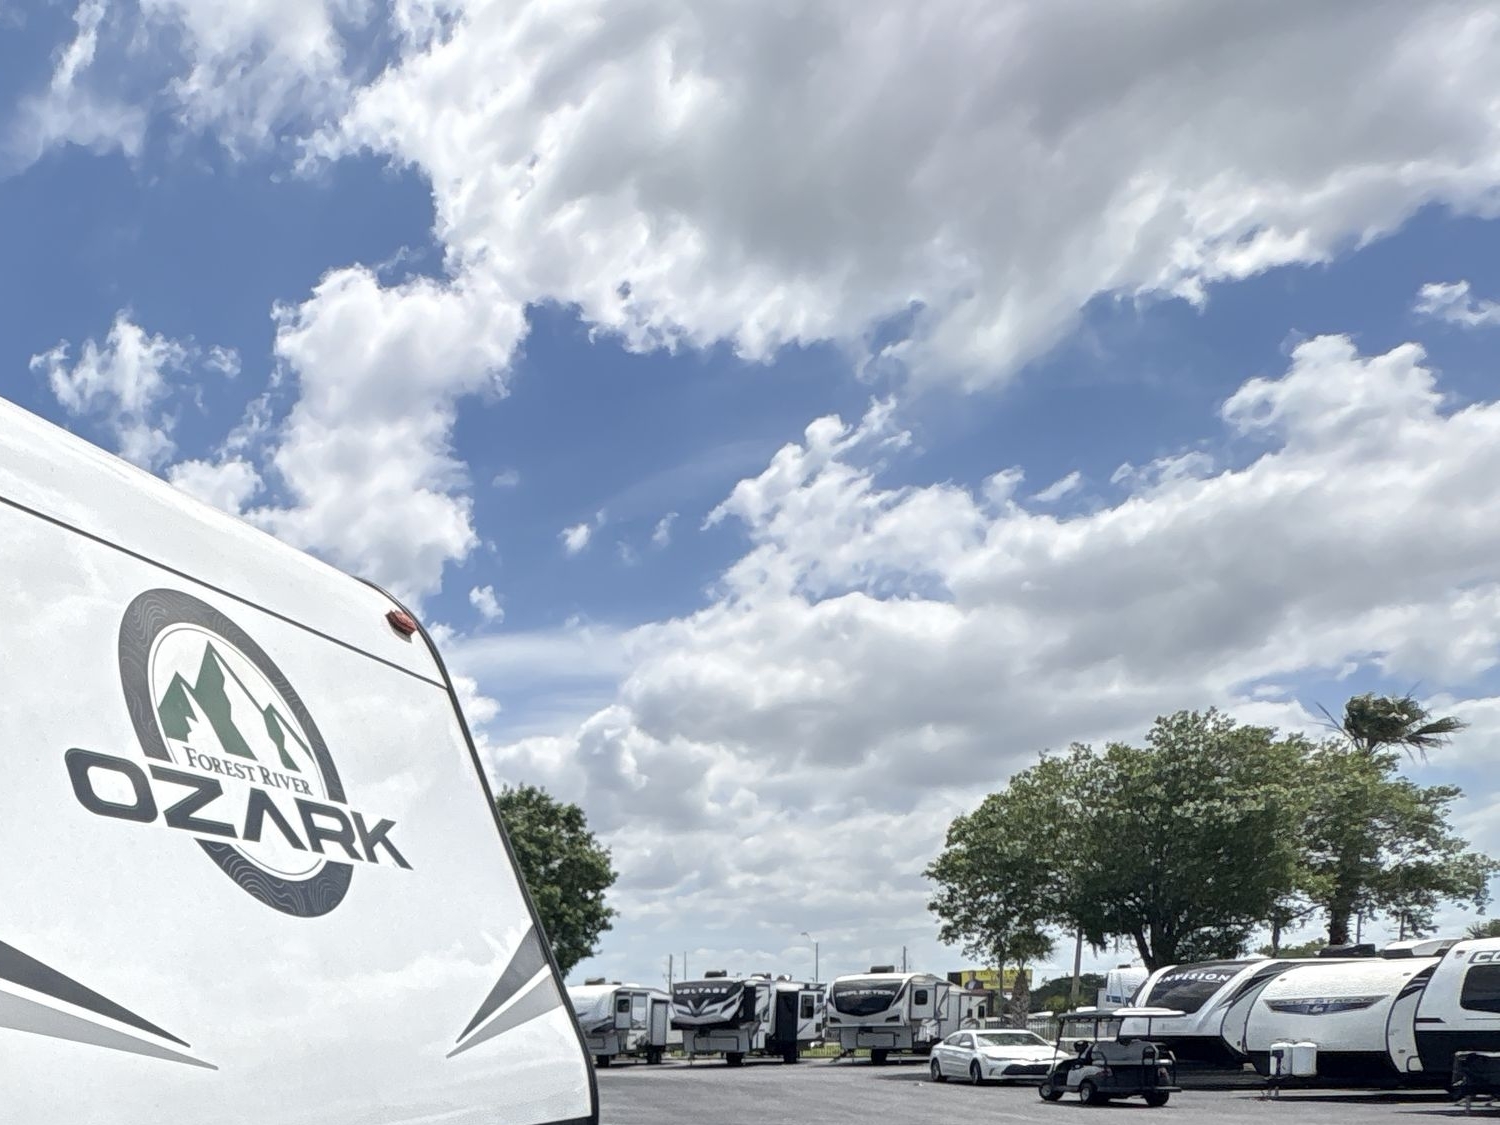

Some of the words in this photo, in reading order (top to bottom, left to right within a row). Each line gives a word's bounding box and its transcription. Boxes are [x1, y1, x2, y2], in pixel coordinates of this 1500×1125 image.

[182, 746, 256, 782] FOREST
[256, 765, 314, 797] RIVER
[64, 747, 414, 871] OZARK
[675, 987, 729, 995] VOLTAGE
